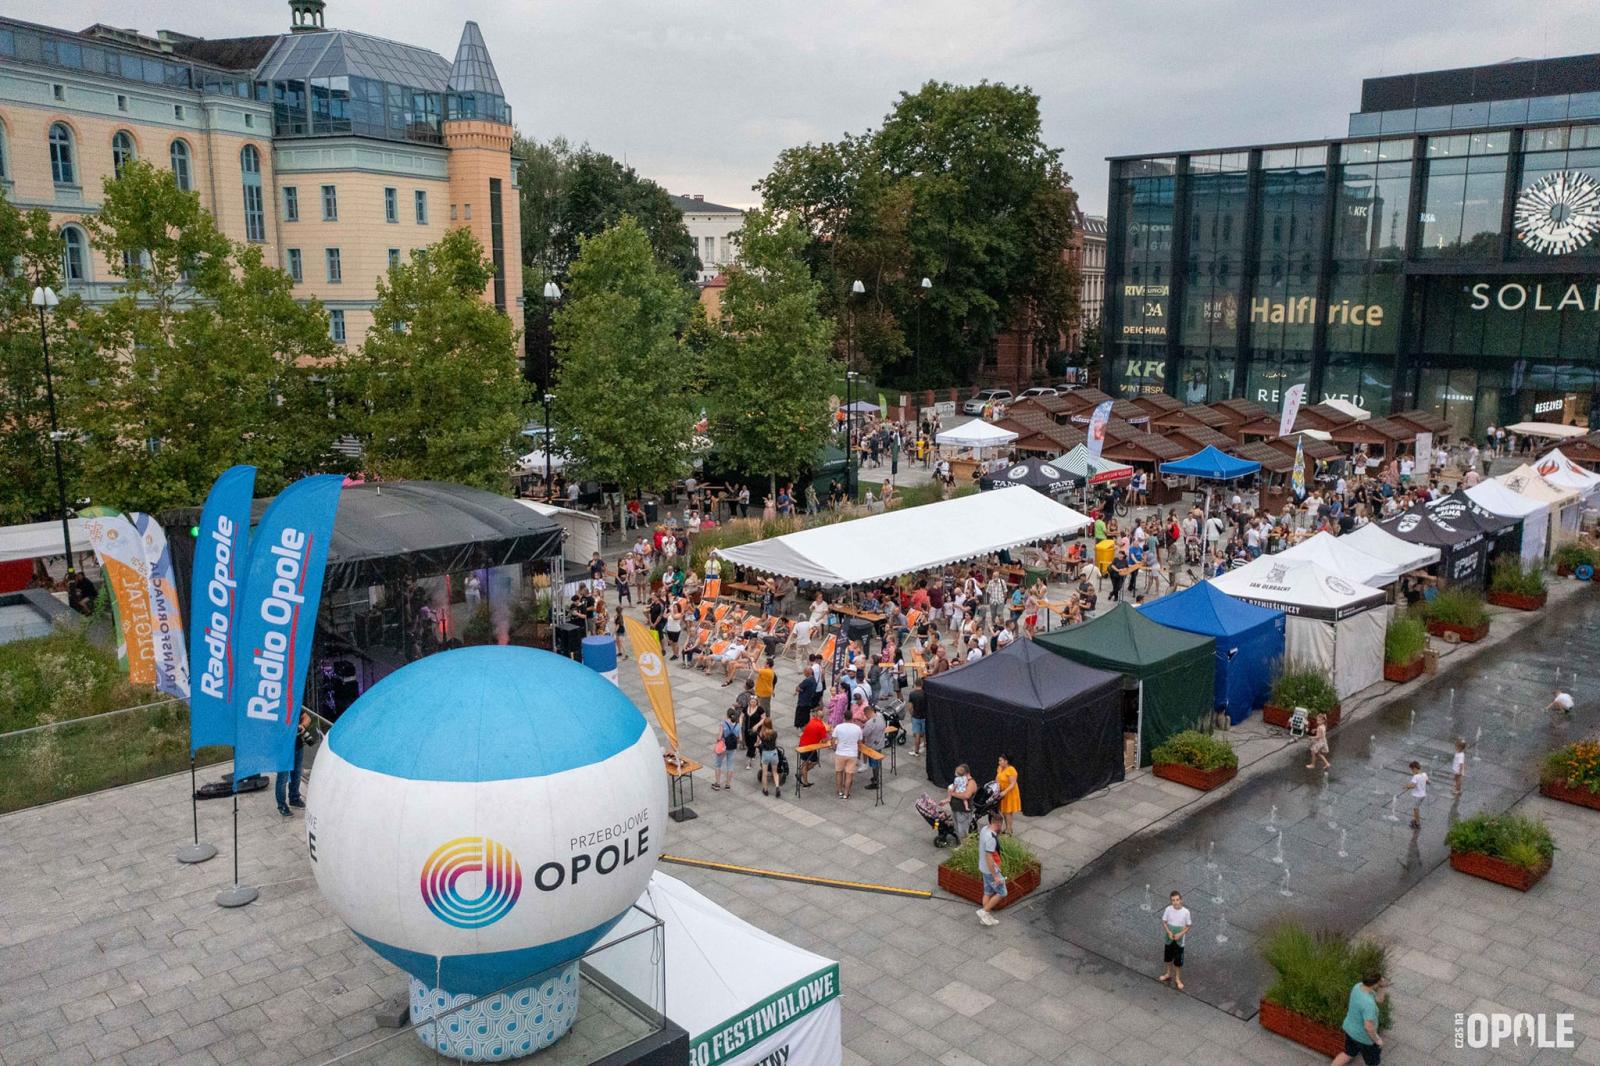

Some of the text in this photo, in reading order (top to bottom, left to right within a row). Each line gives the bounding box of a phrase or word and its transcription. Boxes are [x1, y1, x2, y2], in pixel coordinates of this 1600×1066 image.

[200, 514, 237, 699] Radio Opole
[246, 527, 305, 722] Radio Opole
[534, 825, 649, 892] OPOLE
[570, 808, 648, 850] PRZEBOJOWE
[712, 972, 834, 1061] FESTIWALOWE
